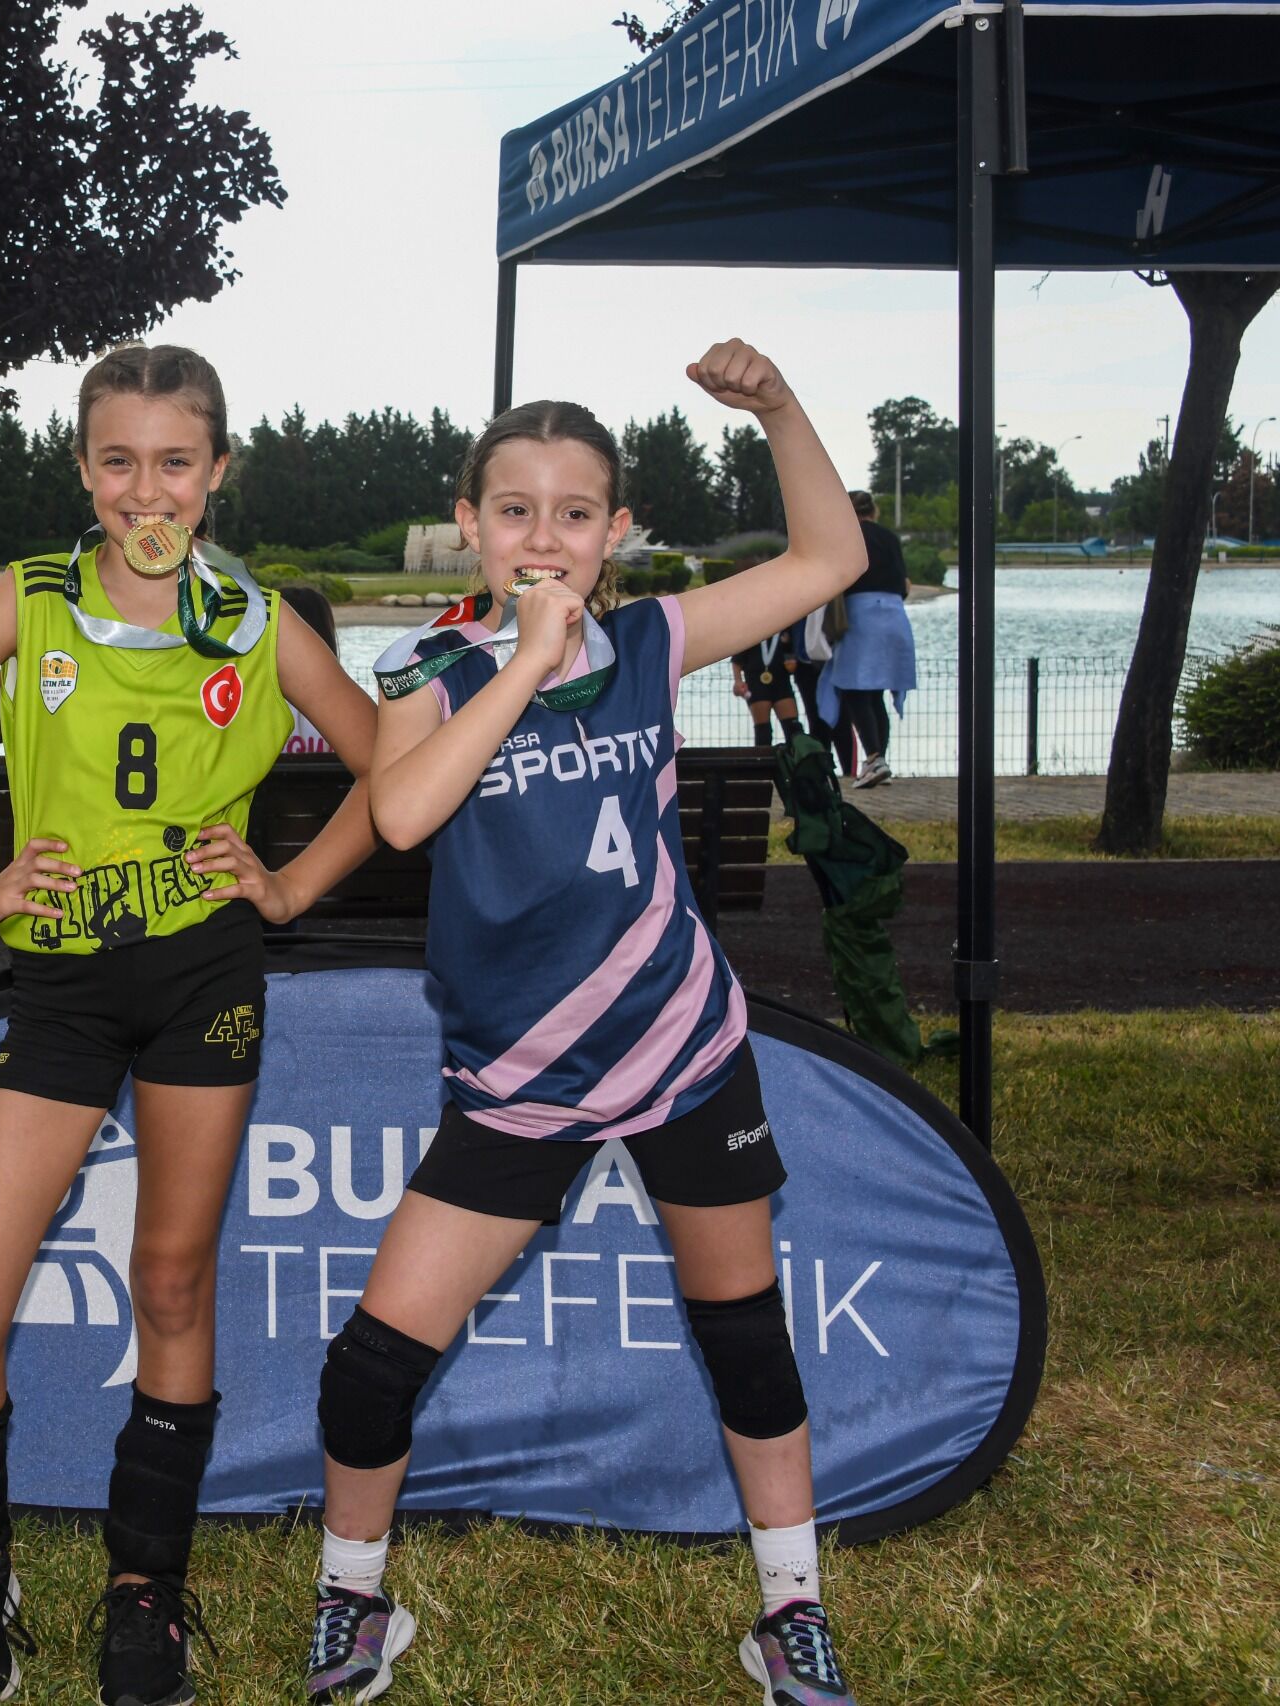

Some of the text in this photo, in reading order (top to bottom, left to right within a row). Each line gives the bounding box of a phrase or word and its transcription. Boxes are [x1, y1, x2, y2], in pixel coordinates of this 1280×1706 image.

[551, 83, 629, 205] BURSA
[140, 539, 158, 560] AYDIN
[146, 534, 164, 557] ERKAN
[392, 667, 421, 684] ERKAN
[501, 732, 541, 751] RSA
[115, 722, 157, 810] 8
[586, 795, 639, 888] 4
[248, 1123, 659, 1225] BUA
[145, 1415, 177, 1431] KIPSTA
